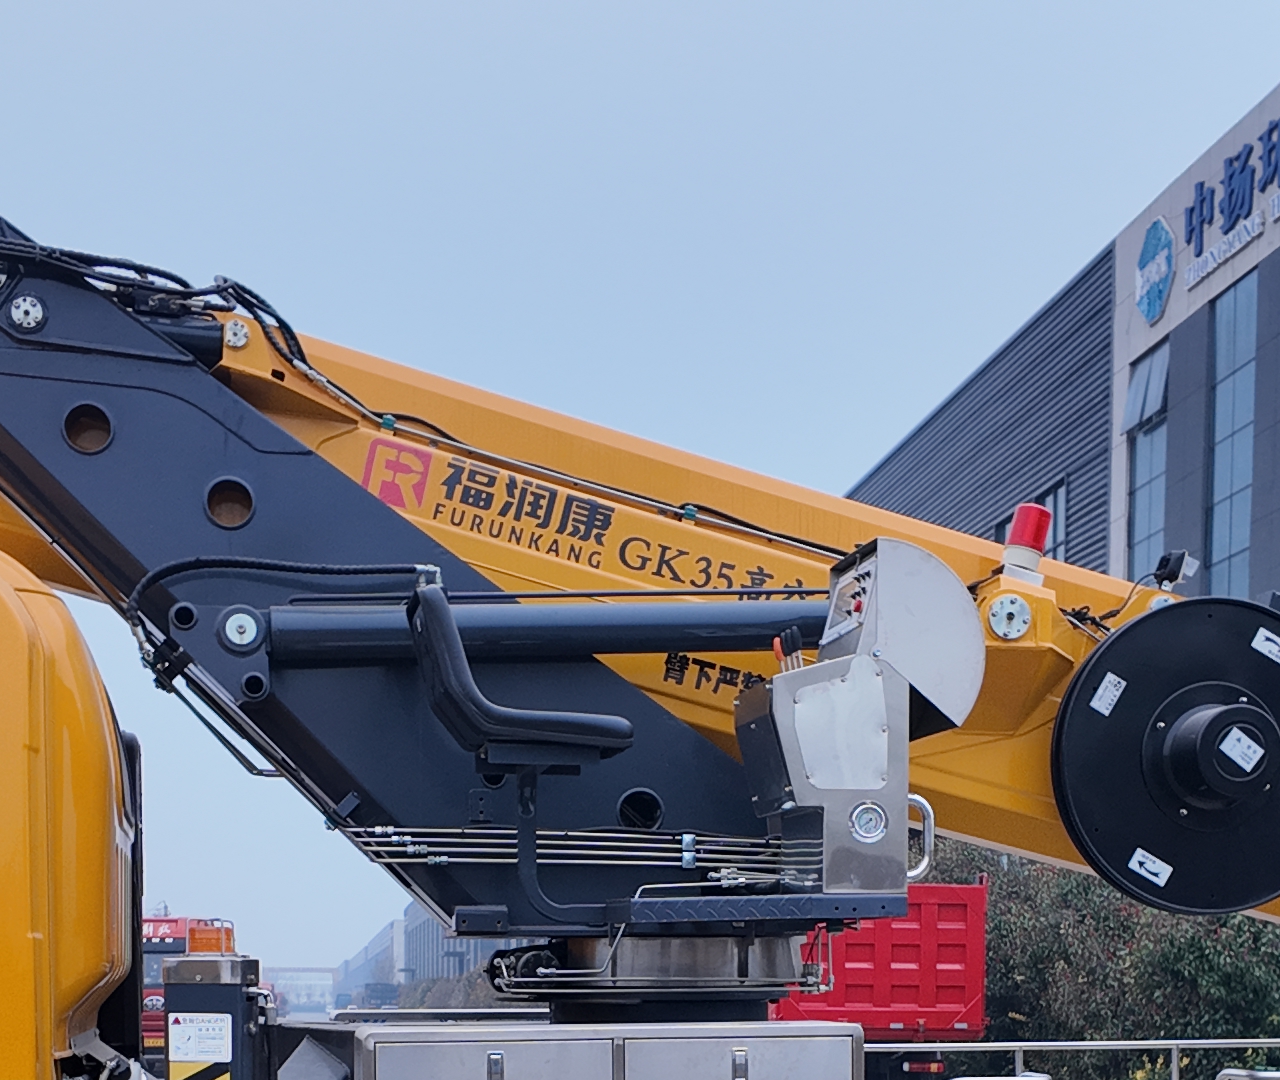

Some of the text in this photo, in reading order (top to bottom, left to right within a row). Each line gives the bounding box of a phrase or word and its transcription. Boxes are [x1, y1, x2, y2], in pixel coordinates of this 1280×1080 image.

[432, 503, 603, 570] FURUNKANG
[440, 457, 616, 548] 福润康
